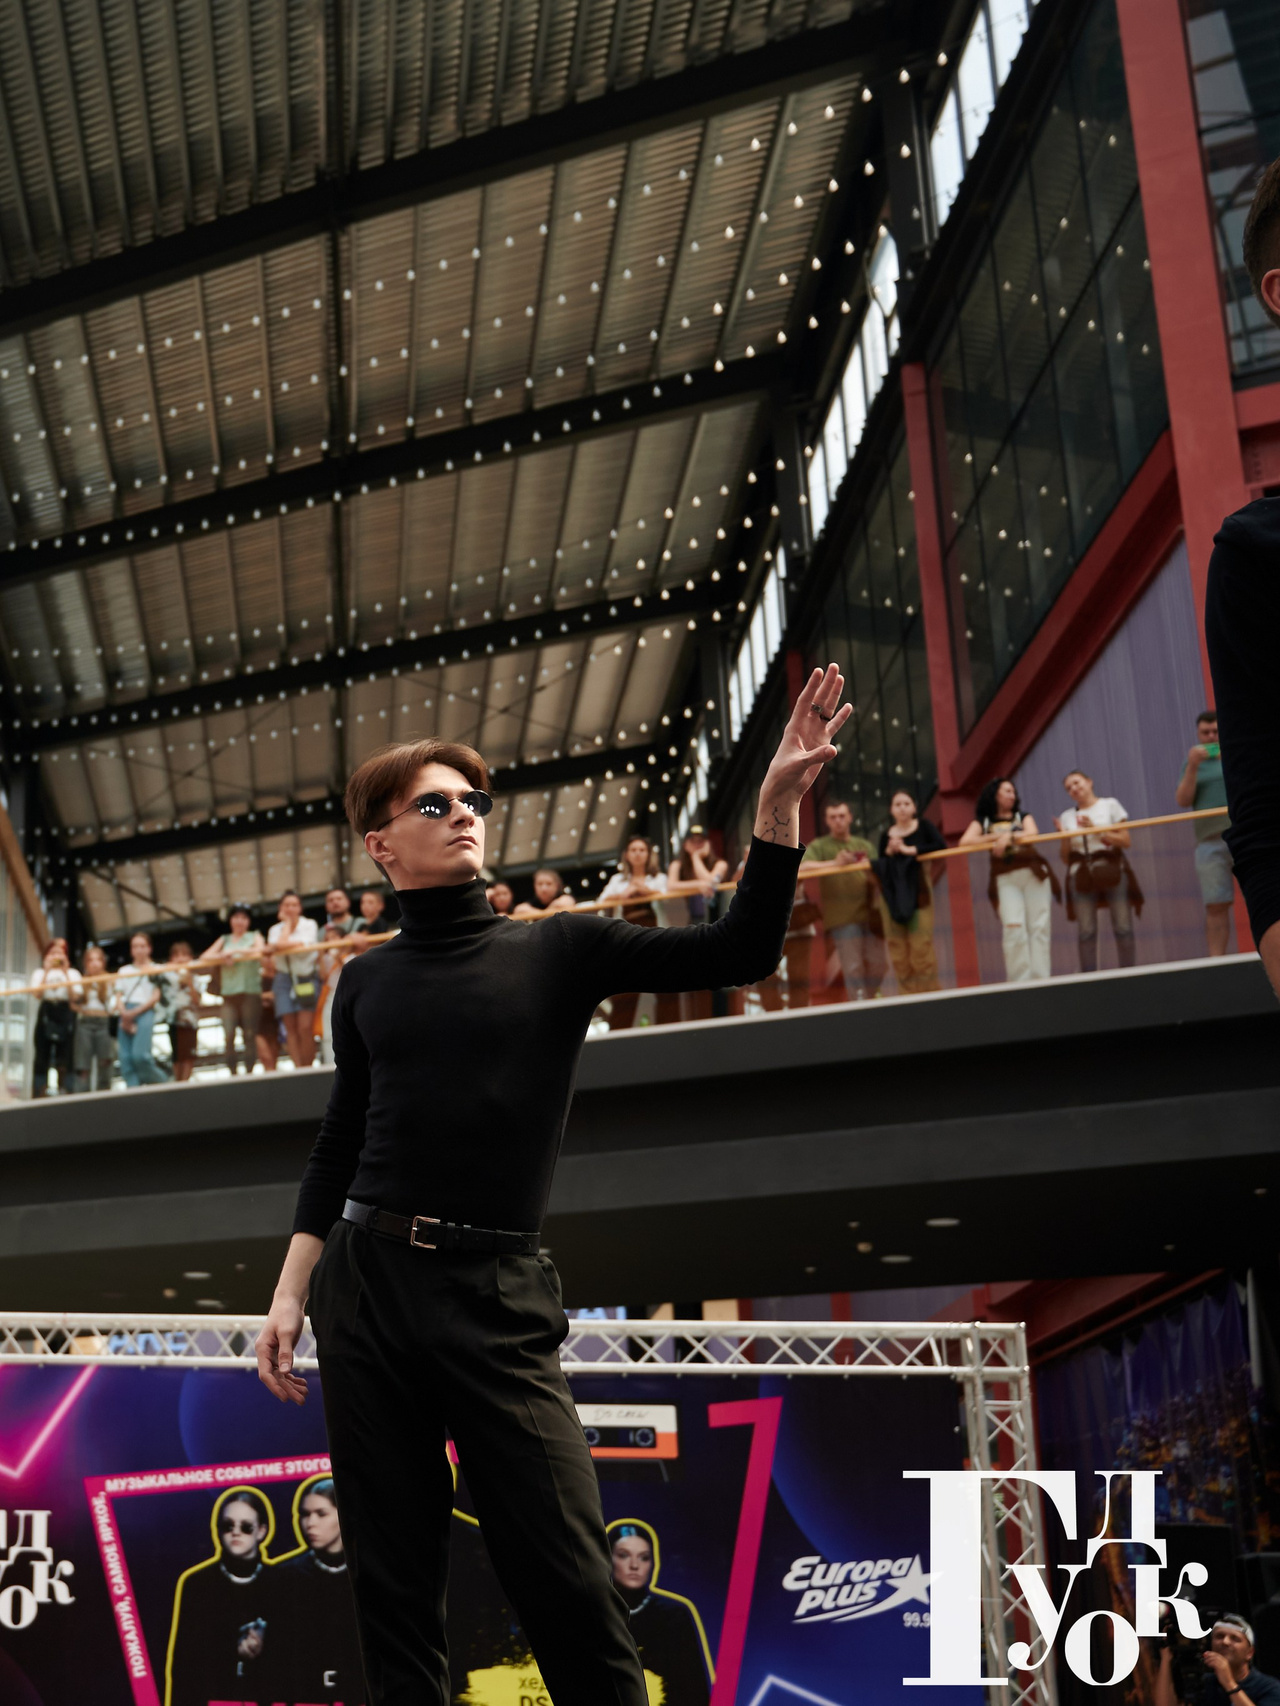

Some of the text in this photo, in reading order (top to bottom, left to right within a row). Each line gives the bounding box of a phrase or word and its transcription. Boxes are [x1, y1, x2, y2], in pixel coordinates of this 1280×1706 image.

[105, 1456, 331, 1493] МУЗЫКАЛЬНОЕ СОБЫТИЕ ЭТОГО
[92, 1491, 147, 1678] ПОЖАЛУЙ, САМОЕ ЯРКОЕ,
[782, 1555, 914, 1591] Europa
